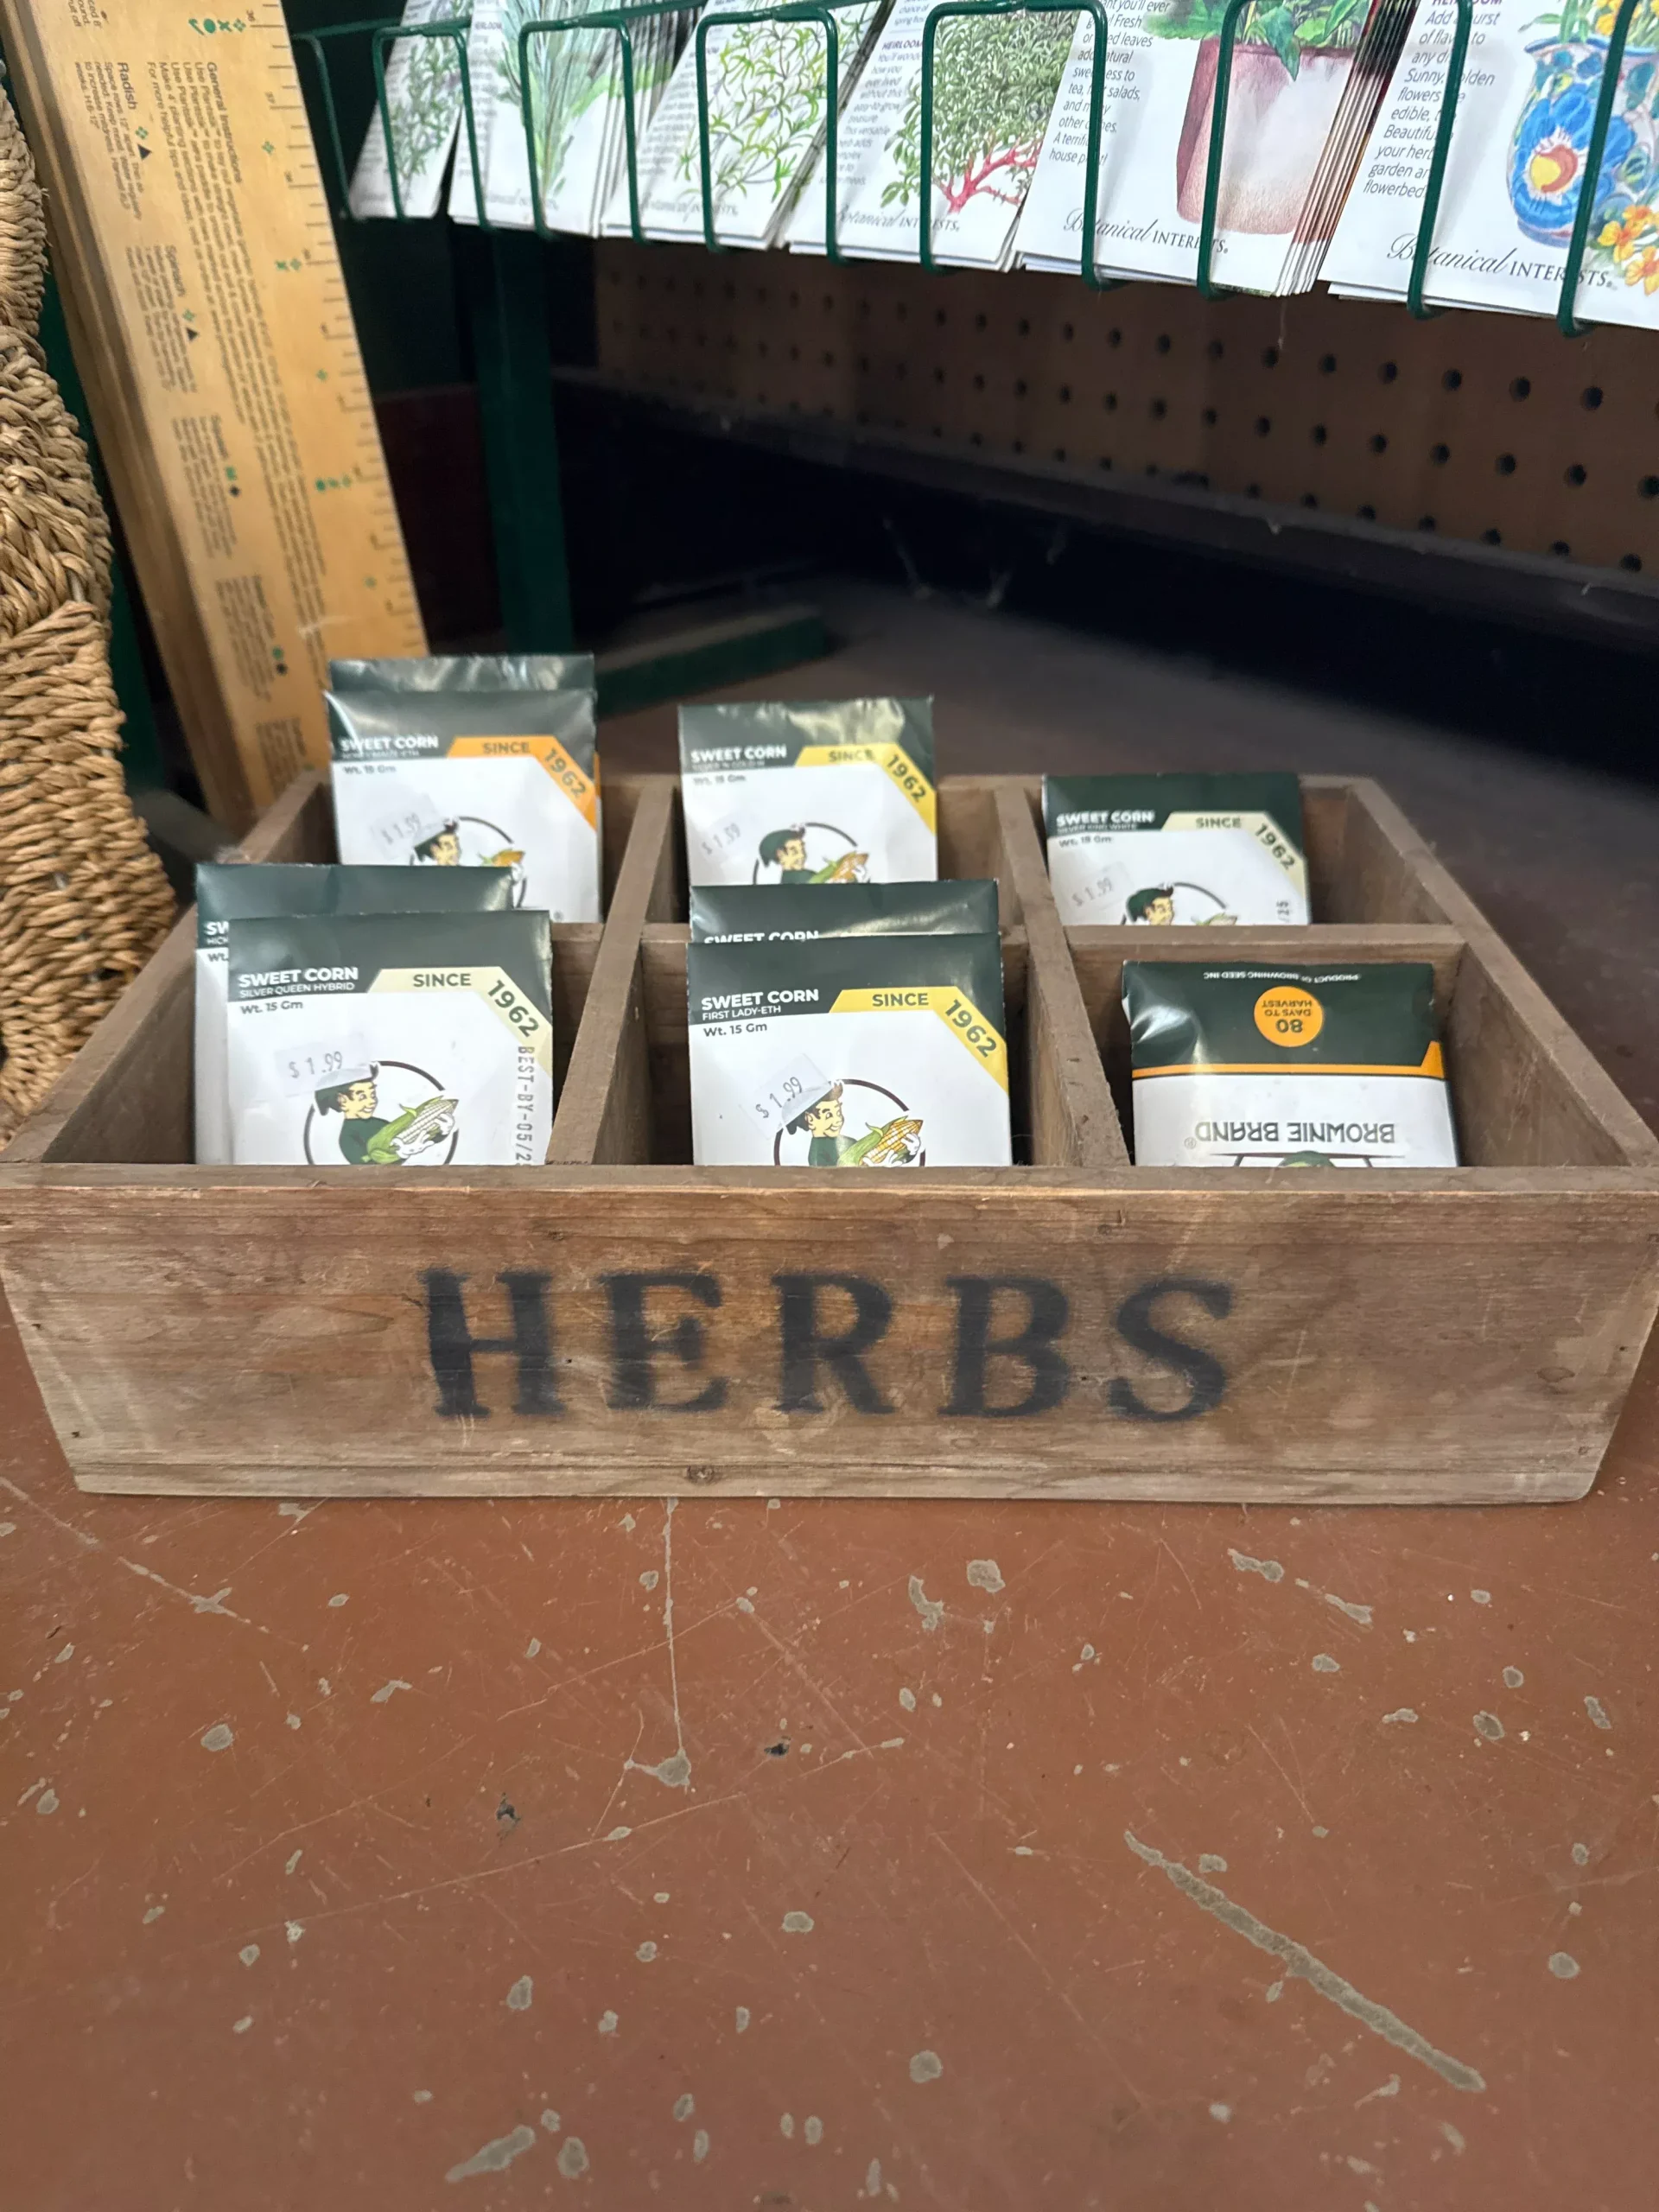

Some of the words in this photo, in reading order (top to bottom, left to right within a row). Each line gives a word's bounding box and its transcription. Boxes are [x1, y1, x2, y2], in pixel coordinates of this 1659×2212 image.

[1147, 3, 1170, 12] ever
[1114, 14, 1142, 29] Fresh
[1425, 10, 1453, 25] Add
[1472, 13, 1501, 26] urst
[1121, 32, 1154, 48] leaves
[1419, 29, 1435, 45] of
[1471, 31, 1485, 45] to
[1105, 50, 1134, 64] atural
[1411, 51, 1434, 67] any
[158, 61, 172, 91] Make
[170, 61, 182, 84] Use
[182, 61, 194, 84] Use
[194, 61, 205, 88] Use
[1123, 69, 1135, 81] to
[1461, 69, 1496, 86] olden
[117, 61, 137, 111] Radish
[1397, 86, 1442, 102] flowers
[147, 61, 156, 80] For
[153, 81, 164, 110] more
[160, 110, 175, 147] helpful
[1063, 99, 1083, 111] and
[1390, 105, 1430, 122] edible,
[207, 61, 227, 111] General
[219, 113, 243, 184] Instructions
[1058, 116, 1085, 130] other
[1053, 131, 1060, 144] A
[1382, 124, 1436, 140] Beautifu
[1049, 148, 1077, 162] house
[1374, 145, 1408, 161] your
[1368, 162, 1413, 178] garden
[1063, 207, 1158, 242] Btanical
[1387, 233, 1517, 275] Btanical
[340, 737, 391, 751] SWEET
[395, 735, 439, 749] CORN
[481, 741, 531, 754] SINCE
[690, 747, 743, 763] SWEET
[744, 744, 787, 760] CORN
[828, 749, 876, 762] SINCE
[543, 747, 587, 798] 1962
[887, 753, 927, 803] 1962
[1056, 810, 1109, 827] SWEET
[1110, 810, 1155, 823] CORN
[1195, 817, 1243, 829] SINCE
[1255, 823, 1296, 871] 1962
[238, 969, 302, 988] SWEET
[304, 966, 359, 982] CORN
[413, 973, 471, 988] SINCE
[1204, 971, 1220, 980] INC
[1247, 971, 1300, 981] BROWNING
[1313, 973, 1360, 983] PRODUCT
[240, 987, 274, 998] SILVER
[276, 983, 311, 995] QUEEN
[314, 982, 355, 991] HYBRID
[241, 1004, 263, 1014] Wt.
[266, 1001, 277, 1011] 15
[281, 1001, 303, 1009] Gm
[701, 991, 764, 1011] SWEET
[767, 988, 819, 1004] CORN
[872, 993, 929, 1007] SINCE
[487, 979, 539, 1038] 1962
[702, 1009, 730, 1021] FIRST
[732, 1005, 782, 1018] LADY-ETH
[1282, 1008, 1312, 1017] DAYS
[702, 1026, 728, 1038] Wt.
[729, 1025, 742, 1035] 15
[746, 1021, 767, 1033] Gm
[944, 999, 998, 1058] 1962
[1275, 1019, 1303, 1033] 80
[515, 1046, 535, 1166] BEST-BY-05/2
[1287, 1122, 1395, 1143] BROWNIE
[422, 1267, 1234, 1424] HERBS
